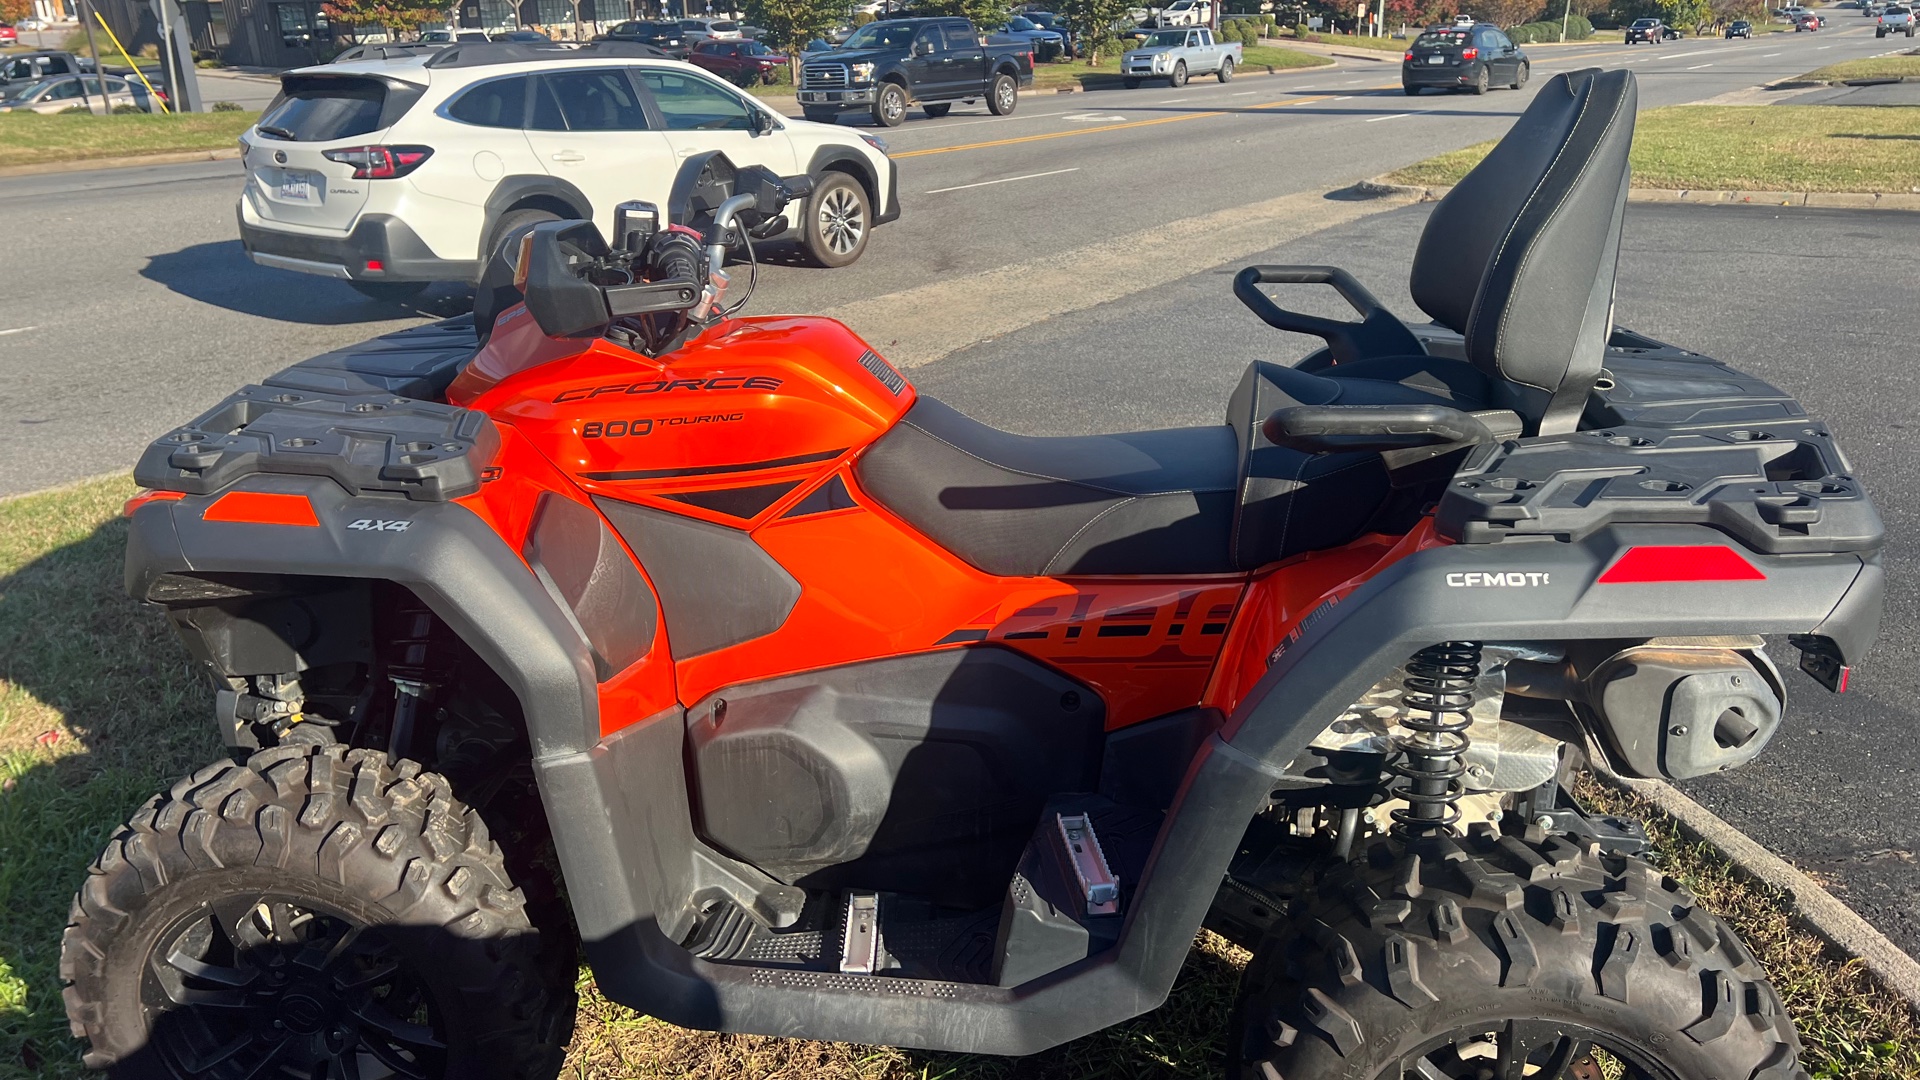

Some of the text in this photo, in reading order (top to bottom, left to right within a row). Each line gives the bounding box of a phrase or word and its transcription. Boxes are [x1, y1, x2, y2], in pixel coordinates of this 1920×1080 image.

[552, 376, 784, 404] CFORCE
[581, 413, 744, 438] 800 TOURING
